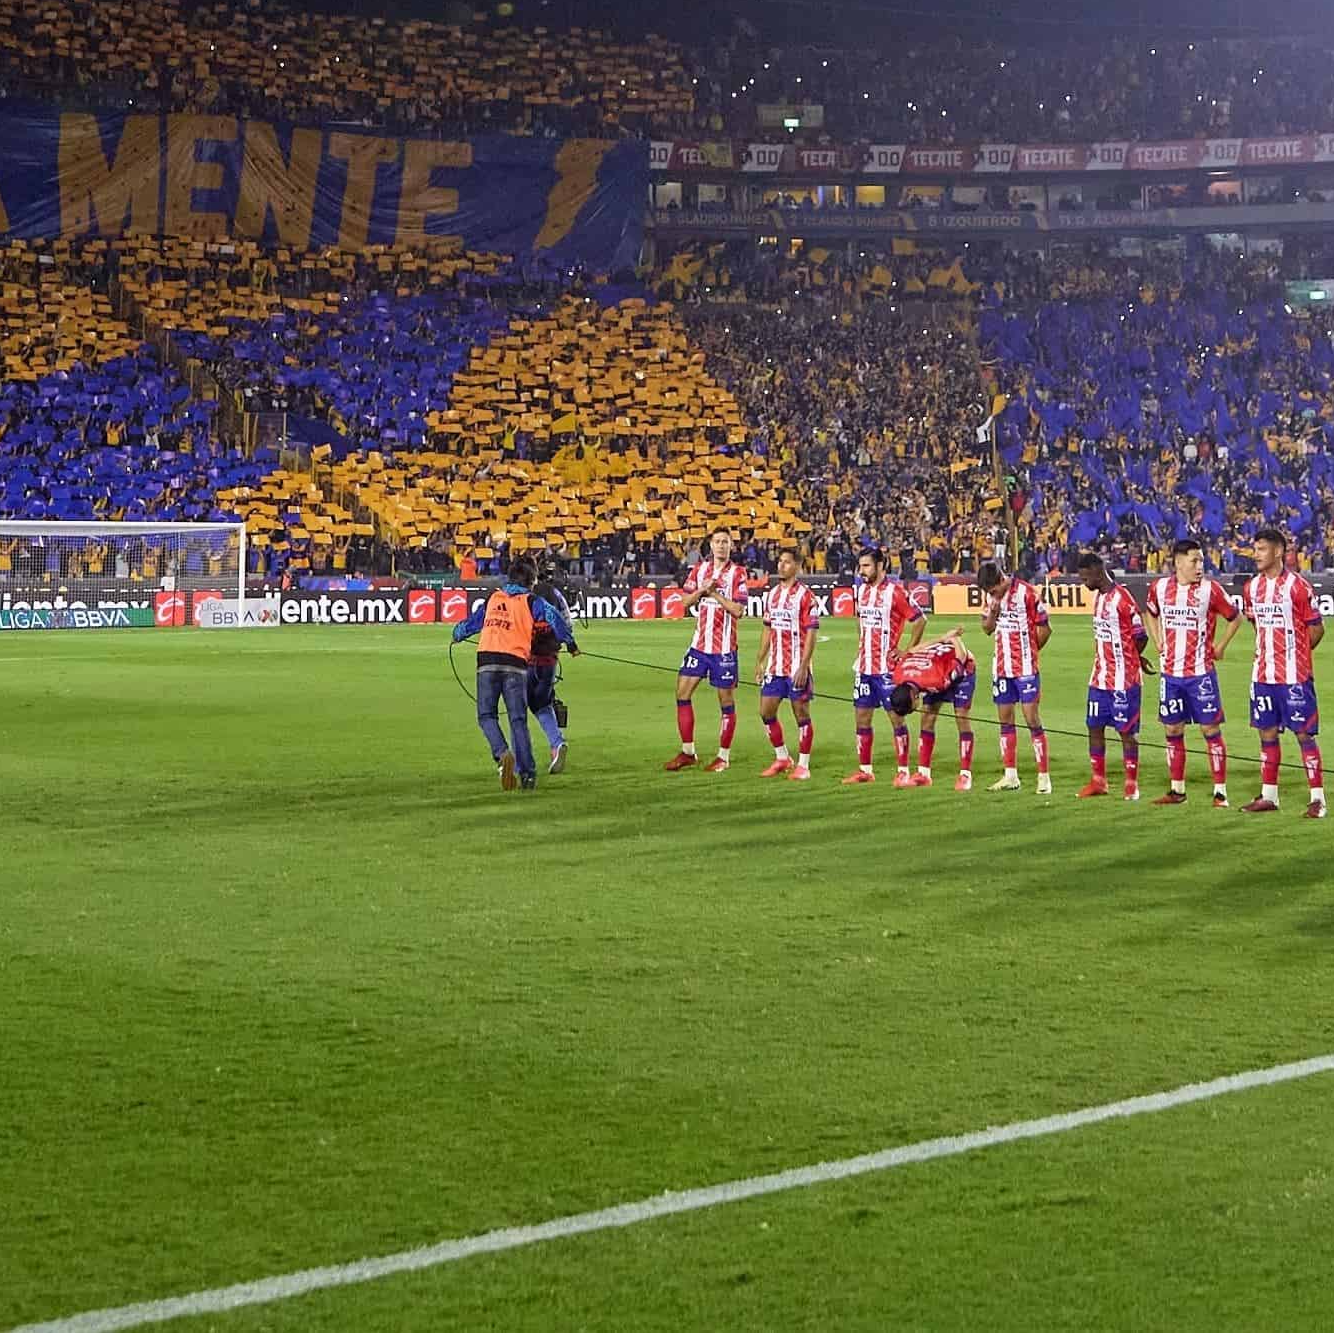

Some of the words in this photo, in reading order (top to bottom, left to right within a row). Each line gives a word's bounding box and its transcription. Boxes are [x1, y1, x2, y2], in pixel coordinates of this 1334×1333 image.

[910, 150, 964, 167] TECATE
[1020, 148, 1076, 167] TECATE
[1135, 145, 1188, 164] TECATE
[1247, 139, 1302, 160] TECATE
[57, 112, 473, 253] MENTE
[201, 601, 224, 611] LIGA
[73, 610, 131, 628] BBVA
[1088, 701, 1099, 717] 11
[1168, 698, 1184, 714] 21
[1256, 696, 1273, 712] 31
